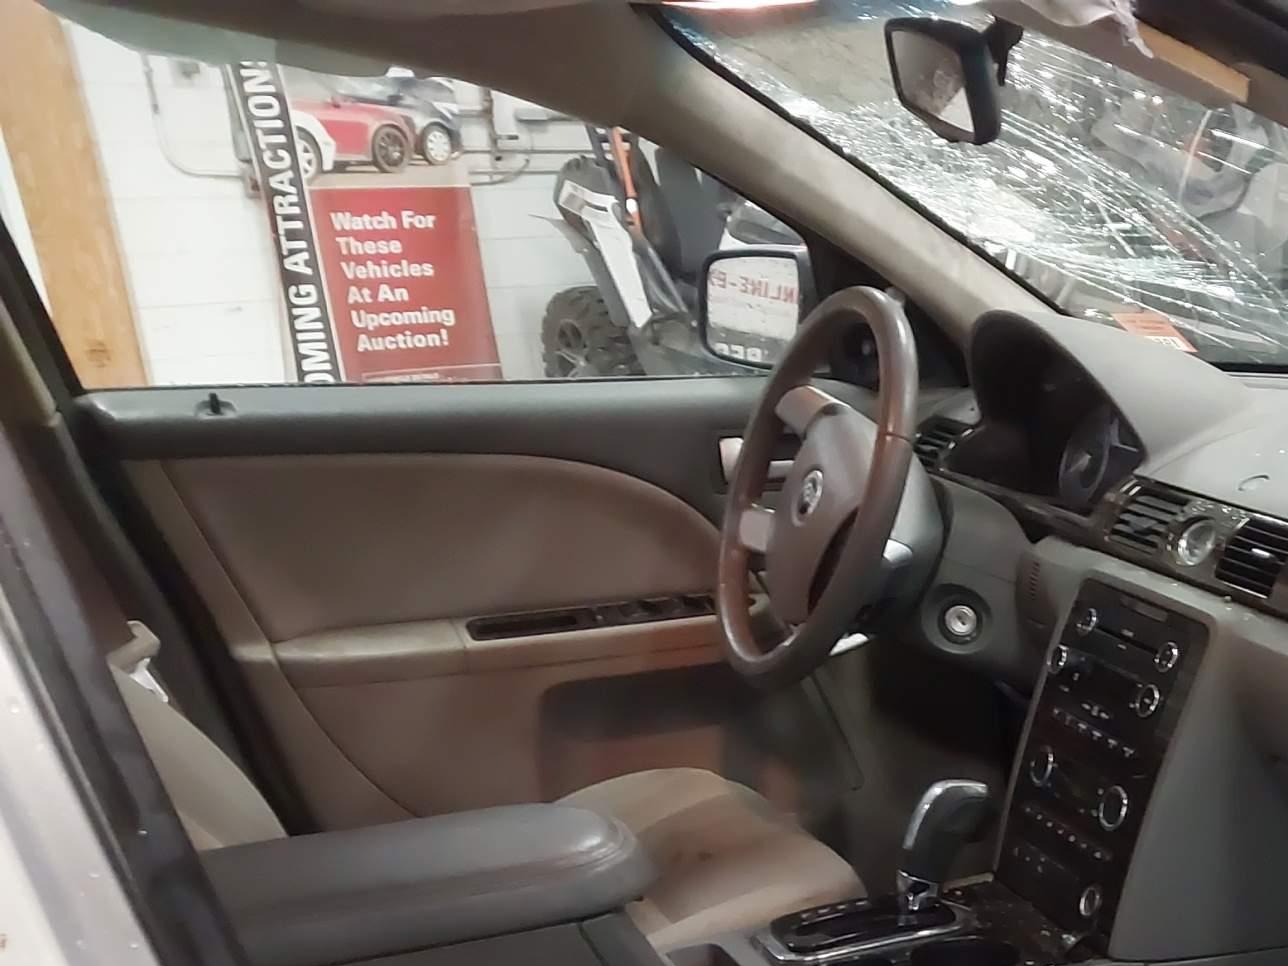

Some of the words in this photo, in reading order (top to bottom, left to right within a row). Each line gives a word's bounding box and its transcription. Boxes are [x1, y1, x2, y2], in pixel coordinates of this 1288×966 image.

[329, 211, 397, 231] Watch
[400, 209, 436, 229] For
[335, 236, 402, 256] These
[339, 259, 435, 280] Vehicles
[347, 285, 373, 304] At
[377, 283, 409, 302] An
[350, 306, 456, 330] Upcoming
[357, 328, 449, 352] Auction!
